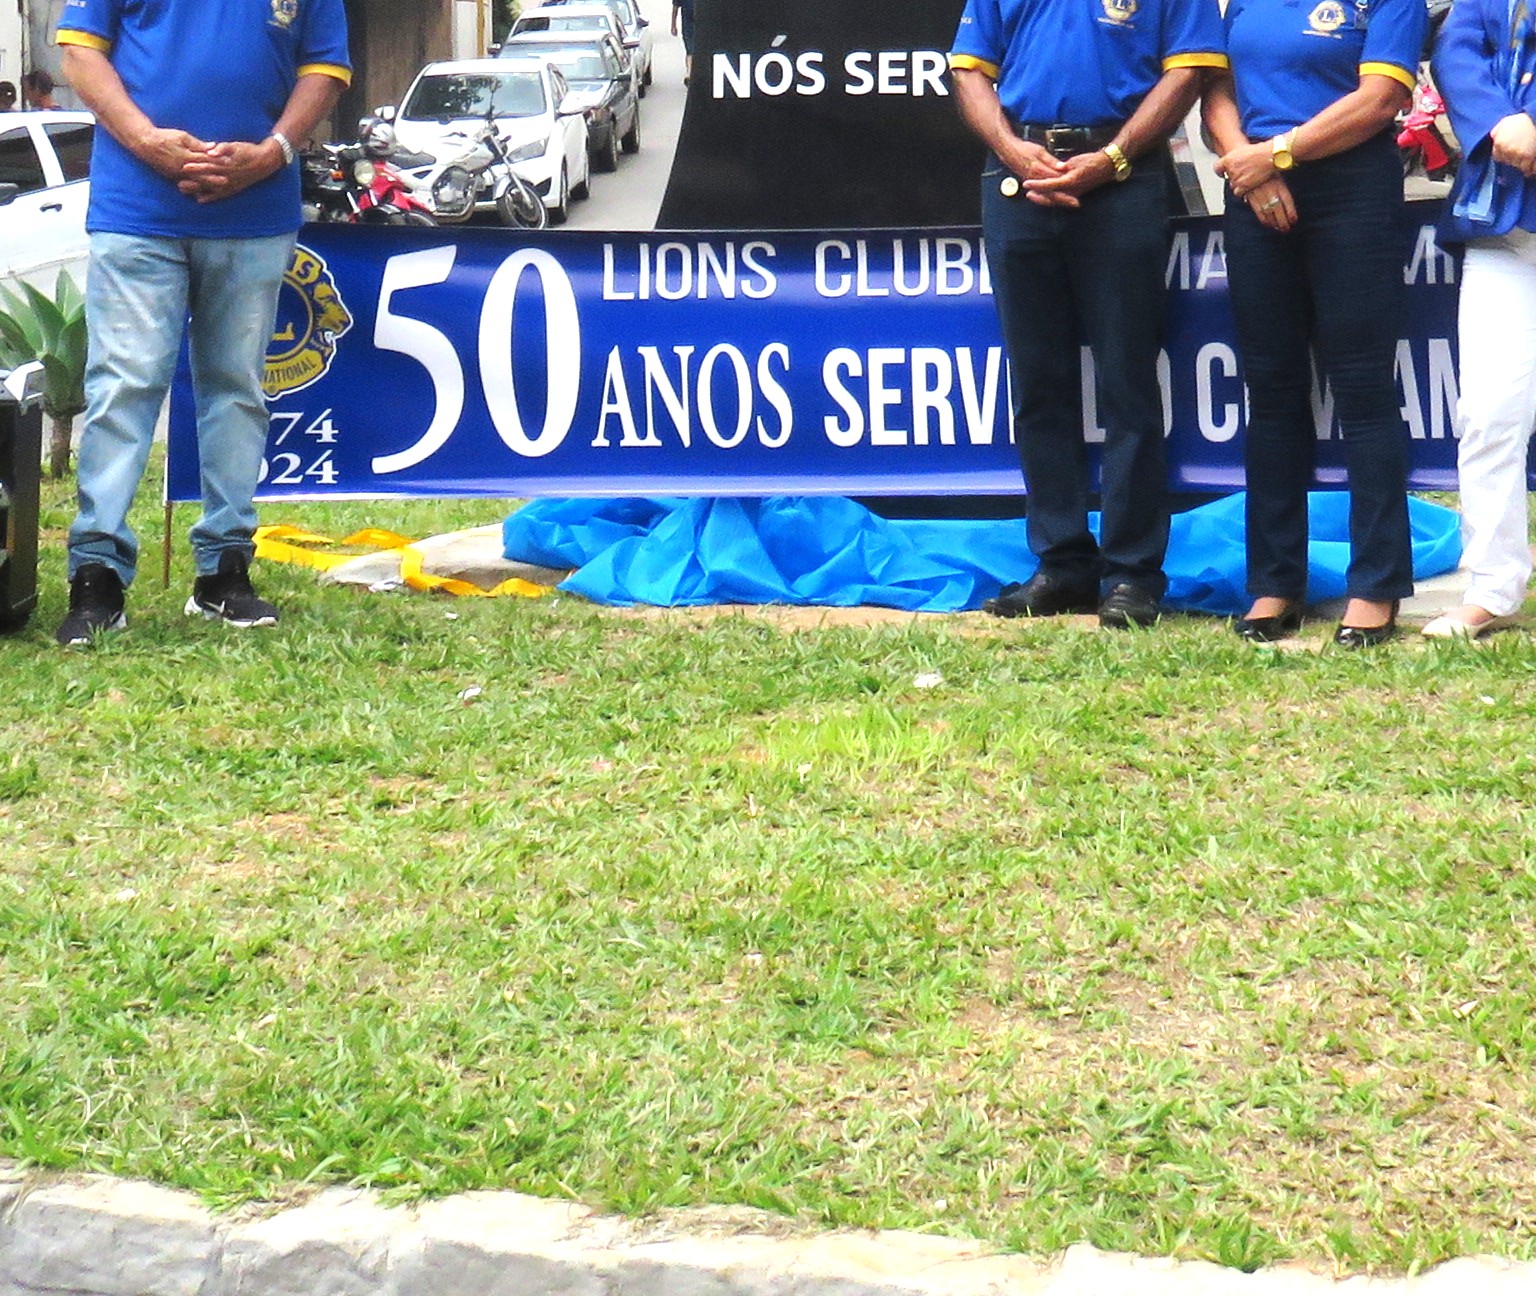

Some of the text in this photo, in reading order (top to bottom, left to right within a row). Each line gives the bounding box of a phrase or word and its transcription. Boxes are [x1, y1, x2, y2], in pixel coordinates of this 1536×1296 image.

[712, 34, 827, 99] NÓS
[601, 240, 778, 301] LIONS
[370, 244, 582, 474] 50
[590, 342, 794, 449] ANOS
